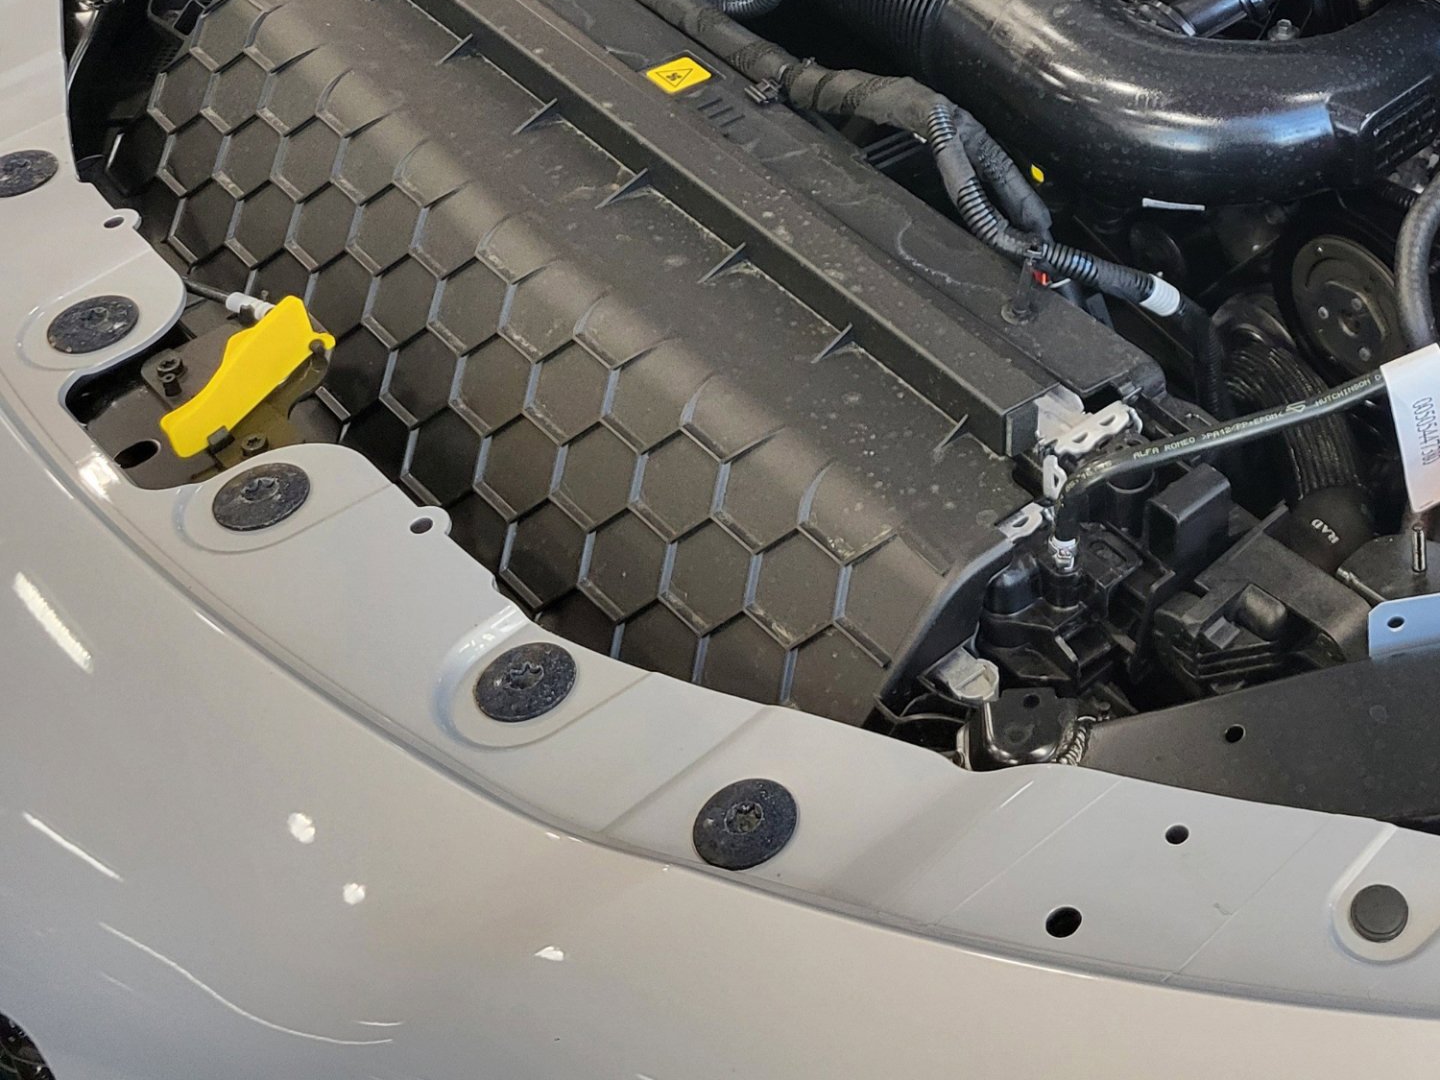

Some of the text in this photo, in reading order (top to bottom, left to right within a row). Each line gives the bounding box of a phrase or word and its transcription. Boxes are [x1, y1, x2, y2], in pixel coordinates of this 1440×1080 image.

[1132, 446, 1160, 460] ALFA
[1164, 436, 1196, 452] ROMEO
[1310, 518, 1340, 544] RAD
